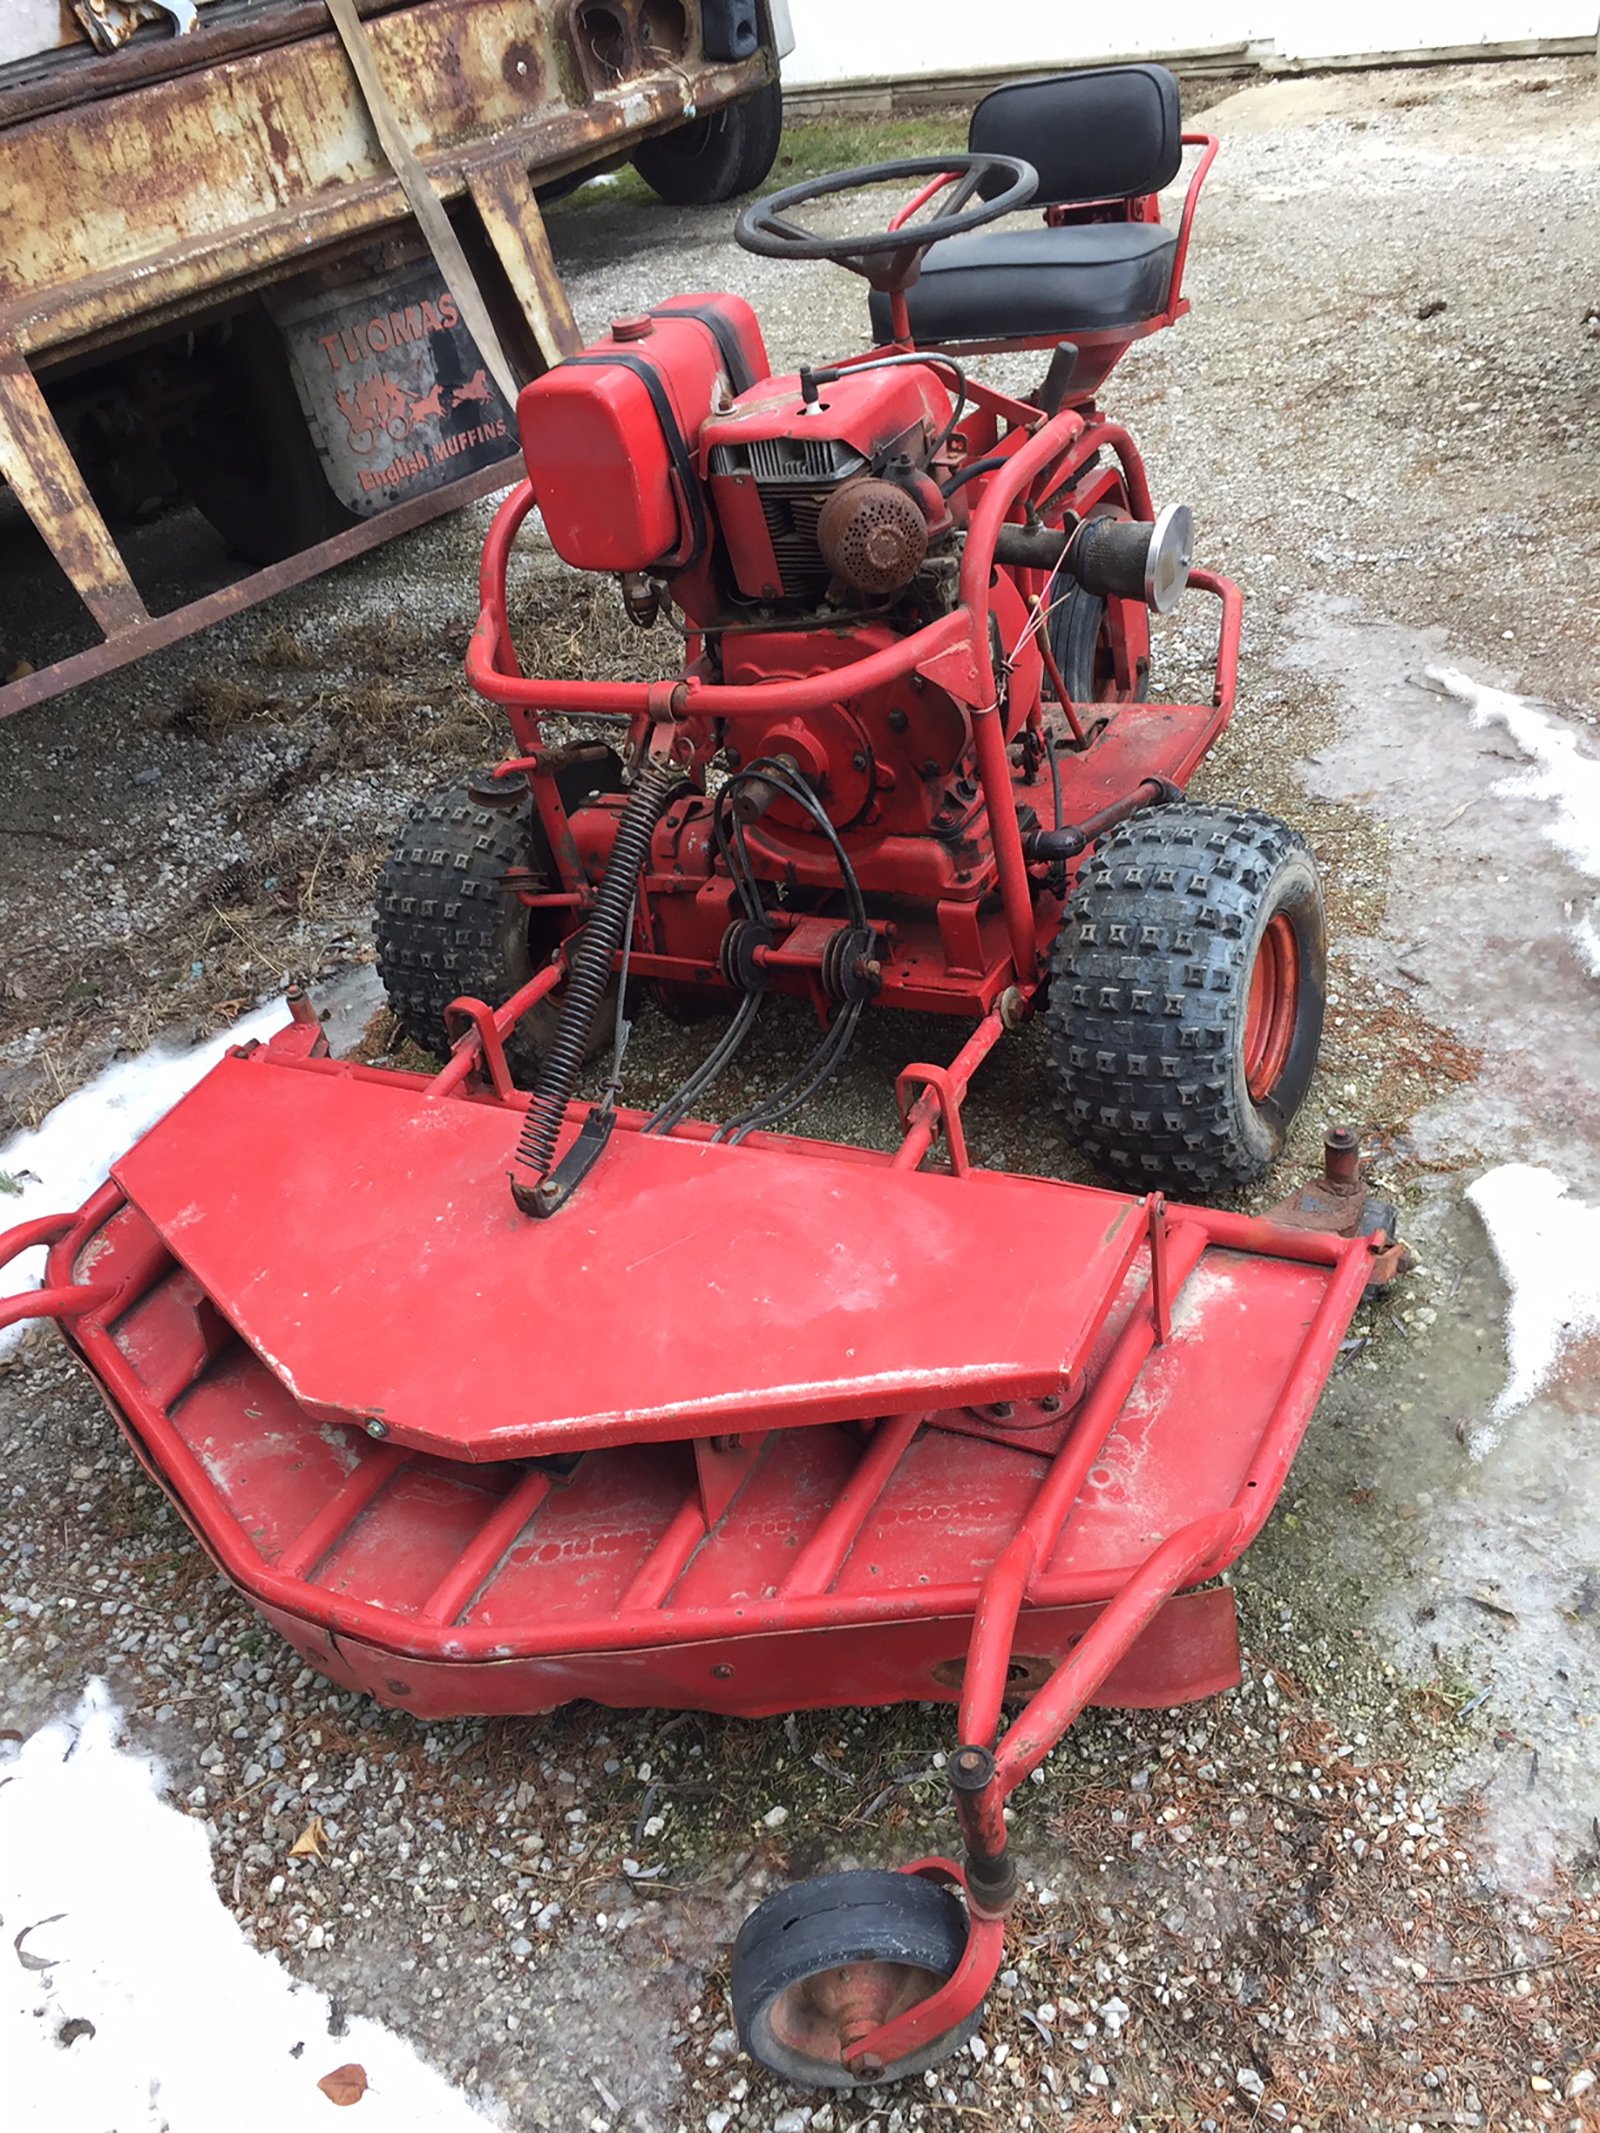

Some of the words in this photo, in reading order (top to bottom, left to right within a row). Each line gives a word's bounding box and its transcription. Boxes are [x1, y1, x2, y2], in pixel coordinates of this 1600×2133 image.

[319, 293, 458, 370] THOMAS
[358, 450, 430, 492] English
[432, 419, 508, 464] MUFFINS
